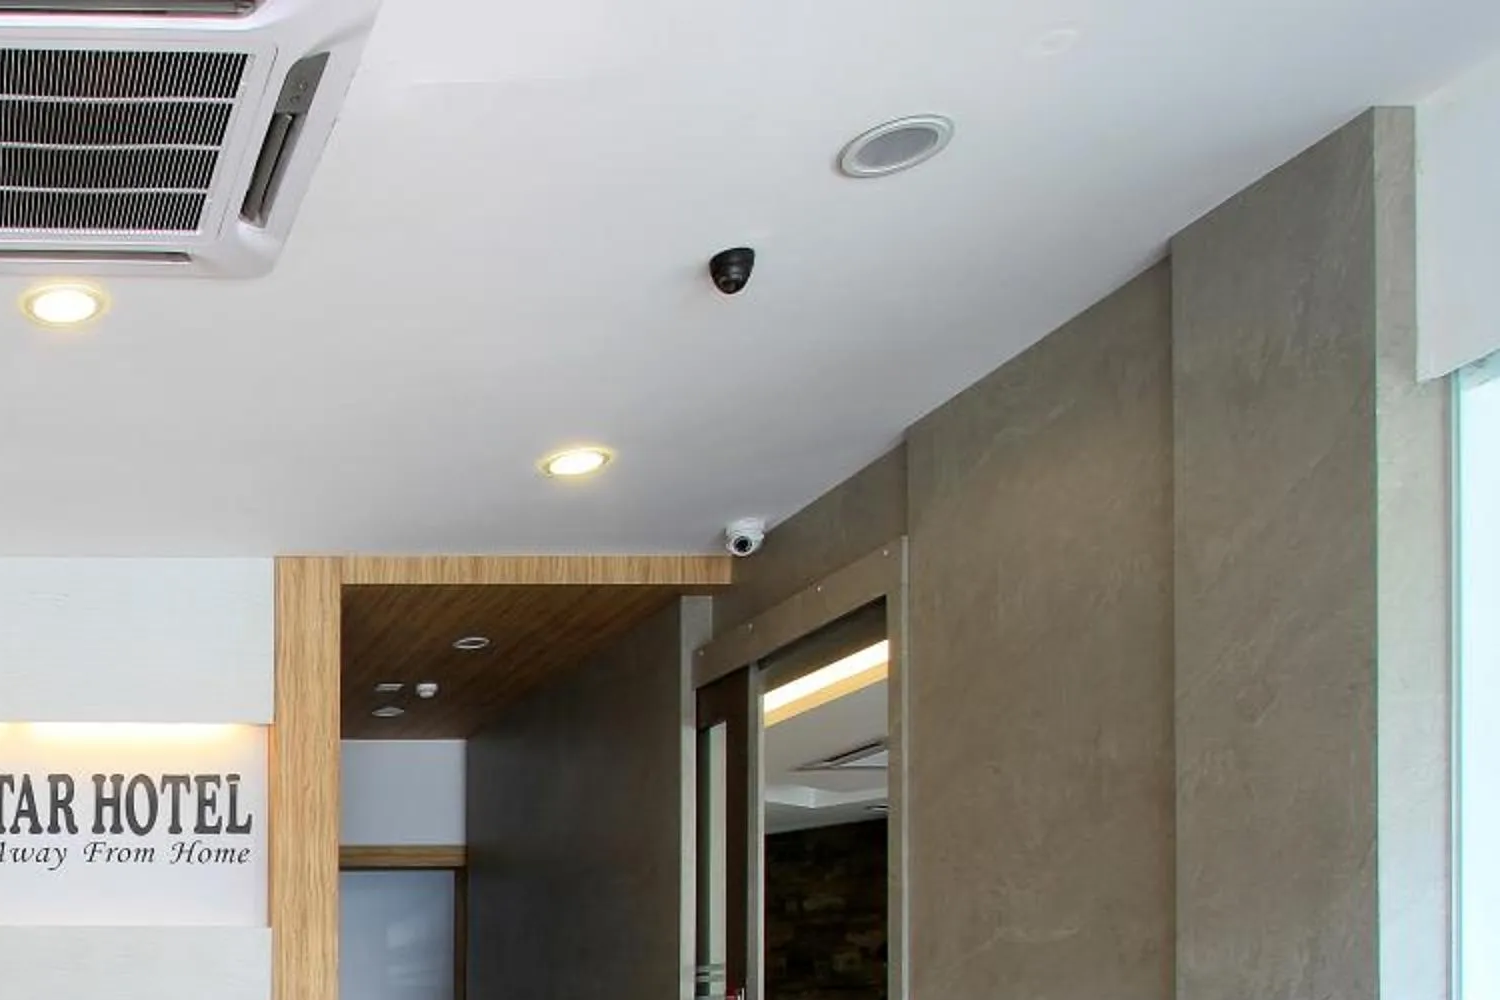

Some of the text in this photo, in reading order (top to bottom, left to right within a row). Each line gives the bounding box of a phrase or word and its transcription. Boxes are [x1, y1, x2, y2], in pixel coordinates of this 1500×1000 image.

[91, 773, 253, 837] HOTEL
[83, 841, 155, 864] From
[170, 840, 251, 865] Home
